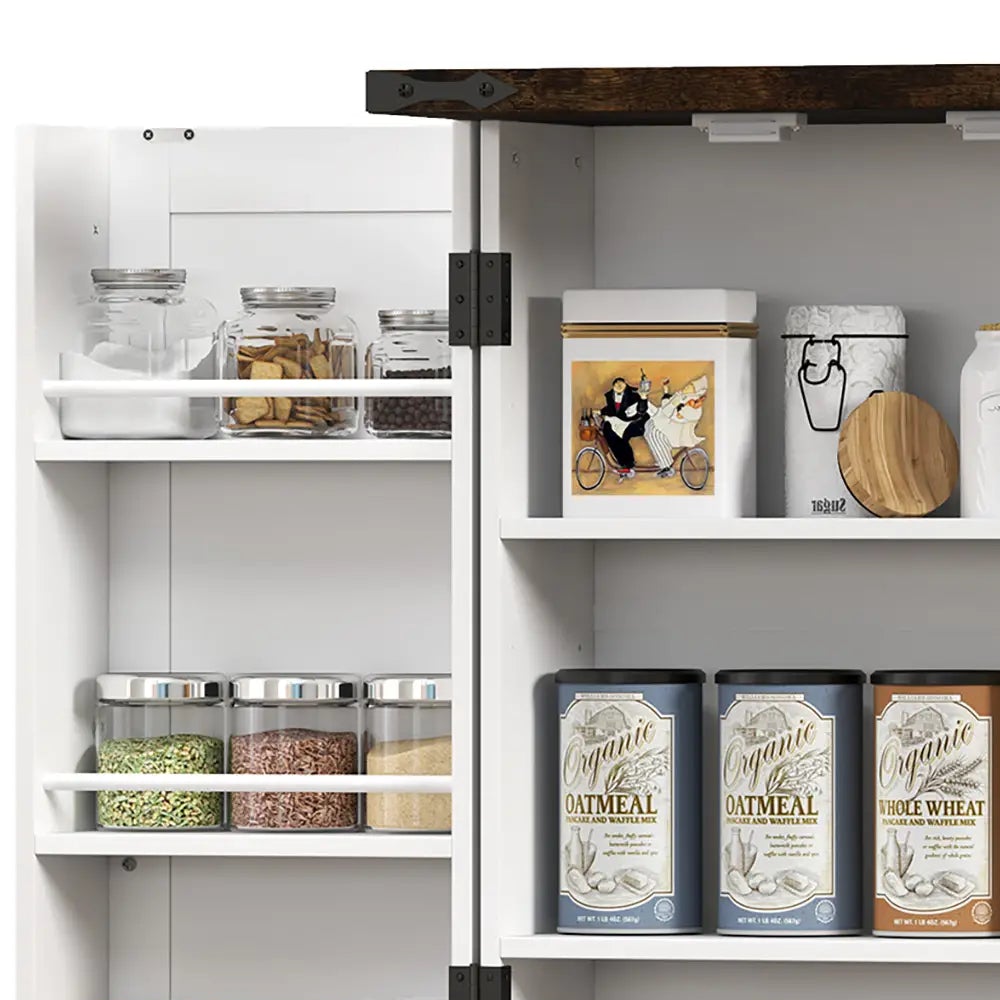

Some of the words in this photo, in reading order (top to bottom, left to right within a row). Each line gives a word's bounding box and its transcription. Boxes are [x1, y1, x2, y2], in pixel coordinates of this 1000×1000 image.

[563, 718, 657, 791] Organic
[724, 719, 816, 793] Organic
[879, 720, 975, 793] Organic
[565, 793, 658, 815] OATMEAL
[726, 794, 819, 816] OATMEAL
[879, 800, 922, 816] WHOLE
[926, 800, 985, 816] WHEAT
[592, 816, 607, 824] AND
[609, 816, 639, 824] WAFFLE
[641, 816, 657, 824] MIX
[910, 818, 925, 826] AND
[927, 818, 959, 826] WAFFLE
[960, 818, 976, 826] MIX
